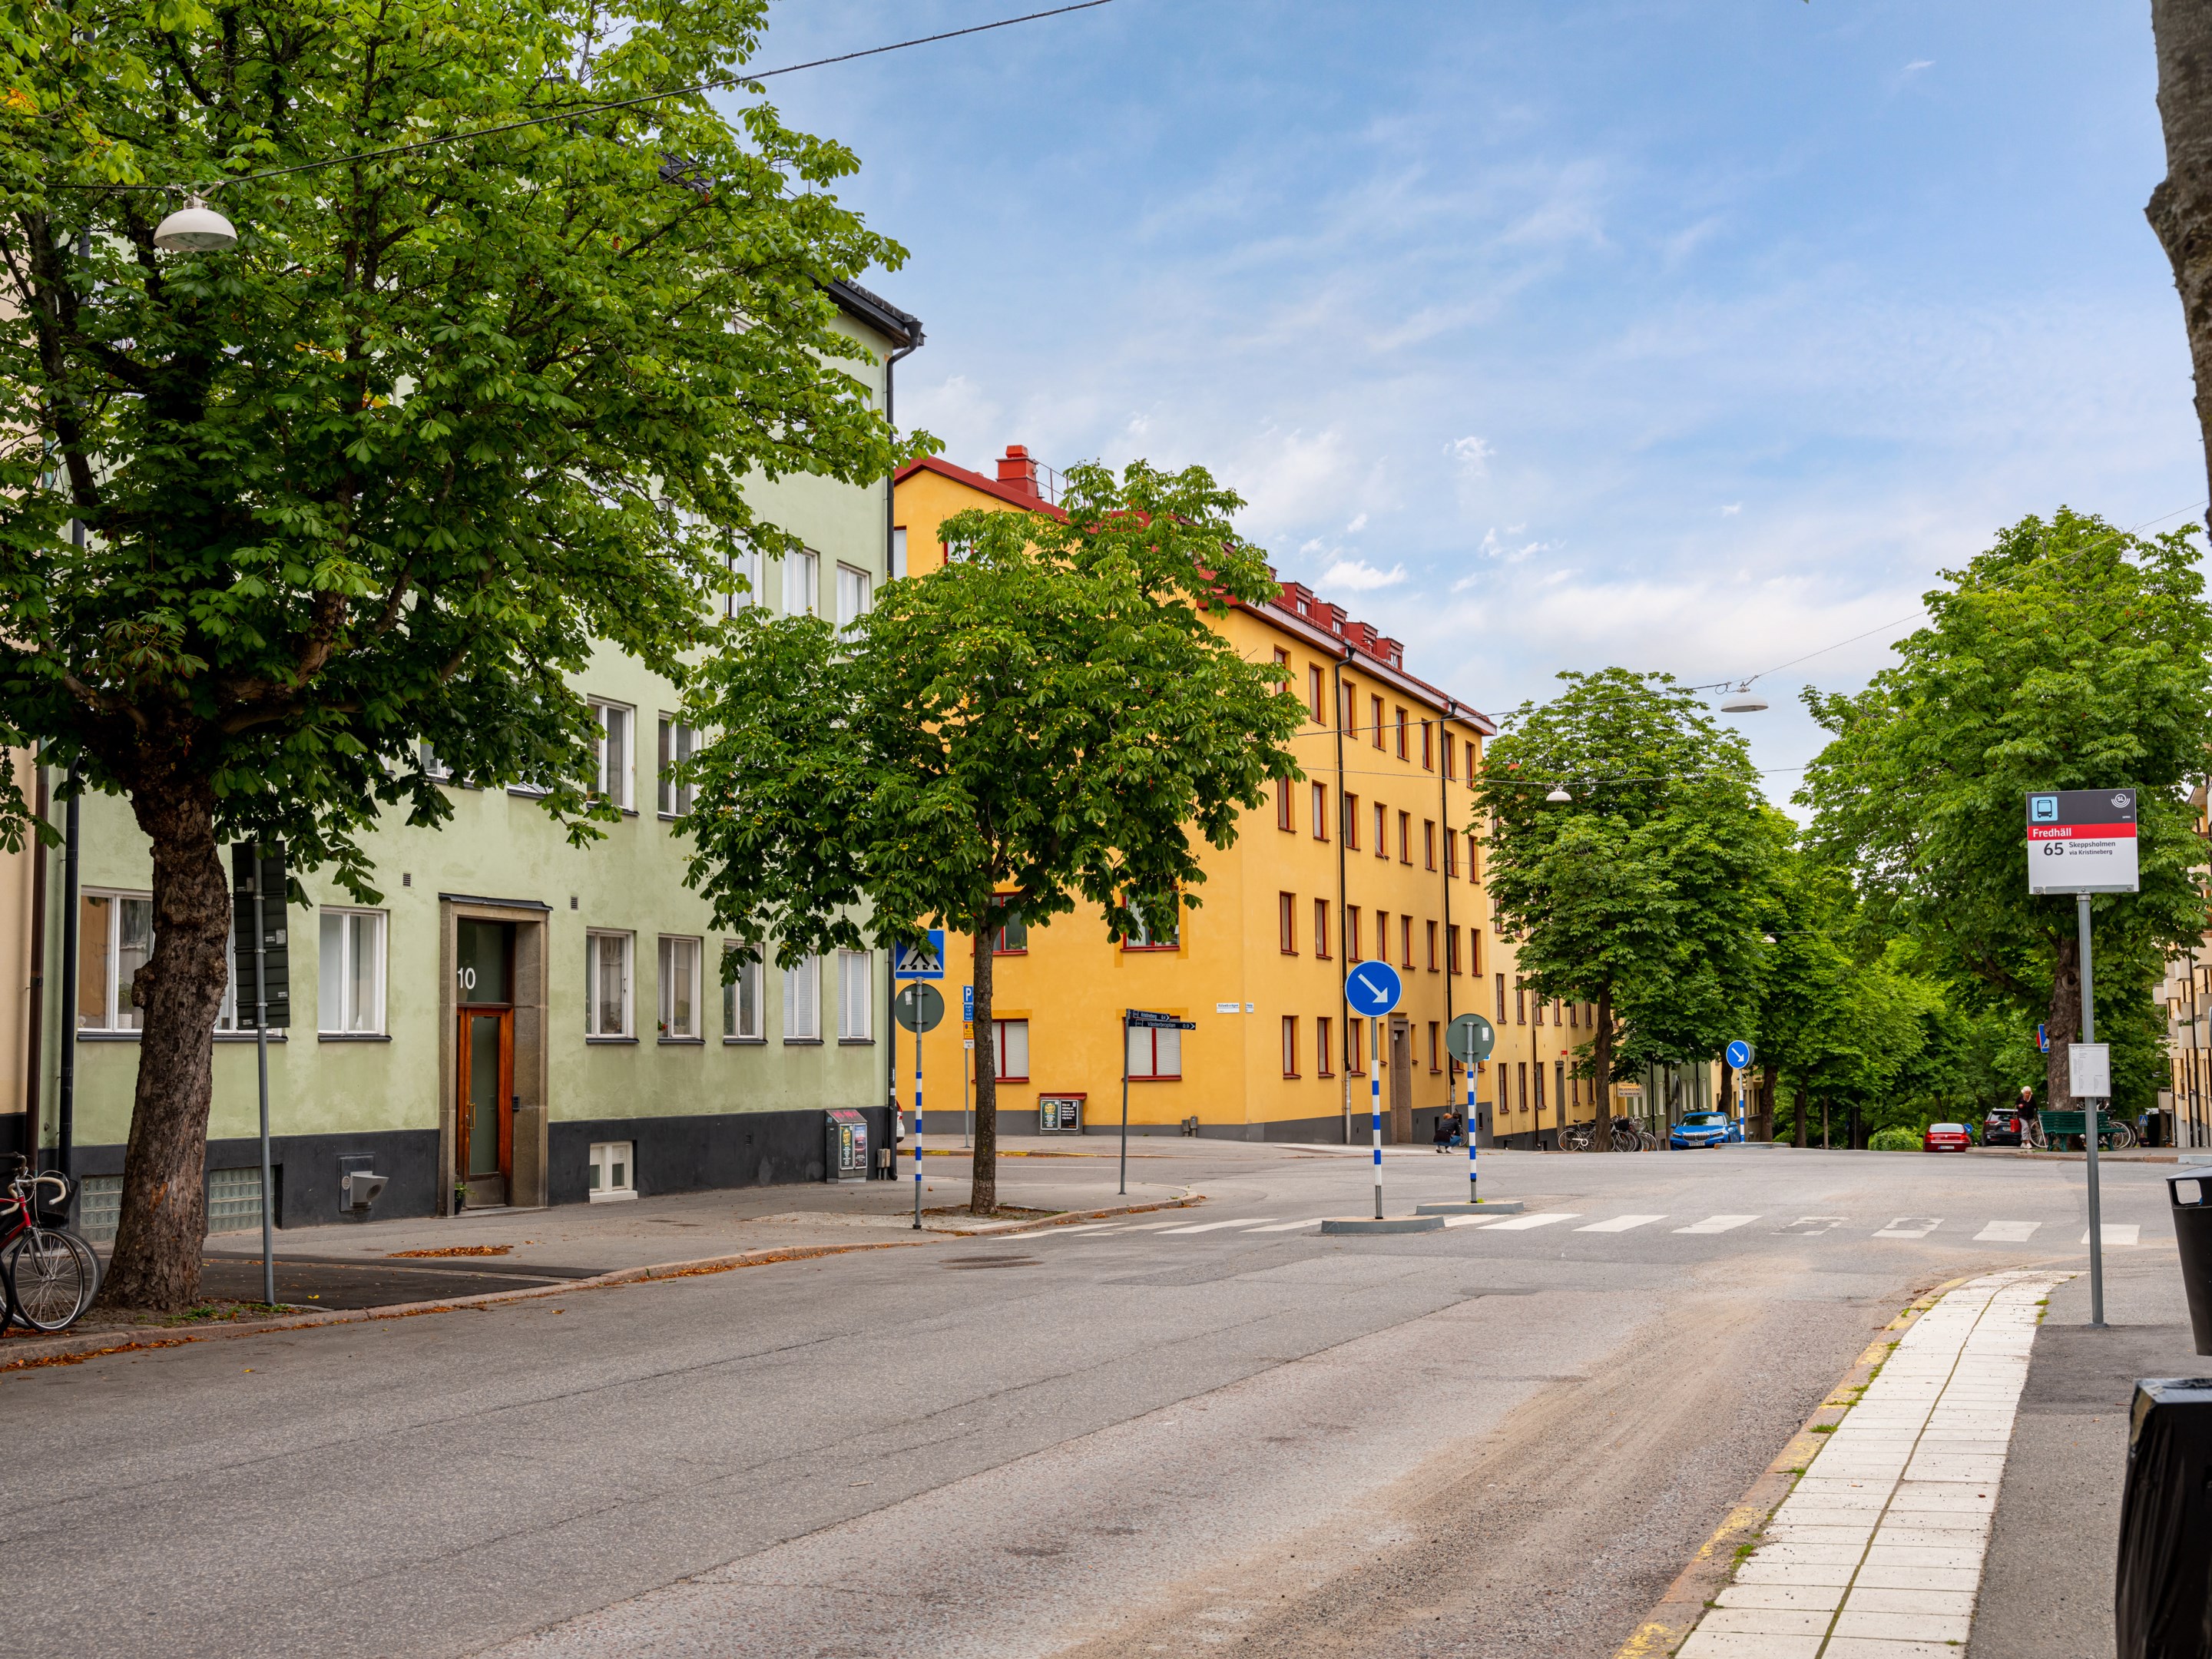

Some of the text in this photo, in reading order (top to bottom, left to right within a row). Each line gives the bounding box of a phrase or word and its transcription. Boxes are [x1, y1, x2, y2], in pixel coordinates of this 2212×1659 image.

[2032, 827, 2072, 838] Fredhäll
[2043, 842, 2064, 856] 65
[457, 967, 476, 990] 10
[965, 987, 972, 1002] P
